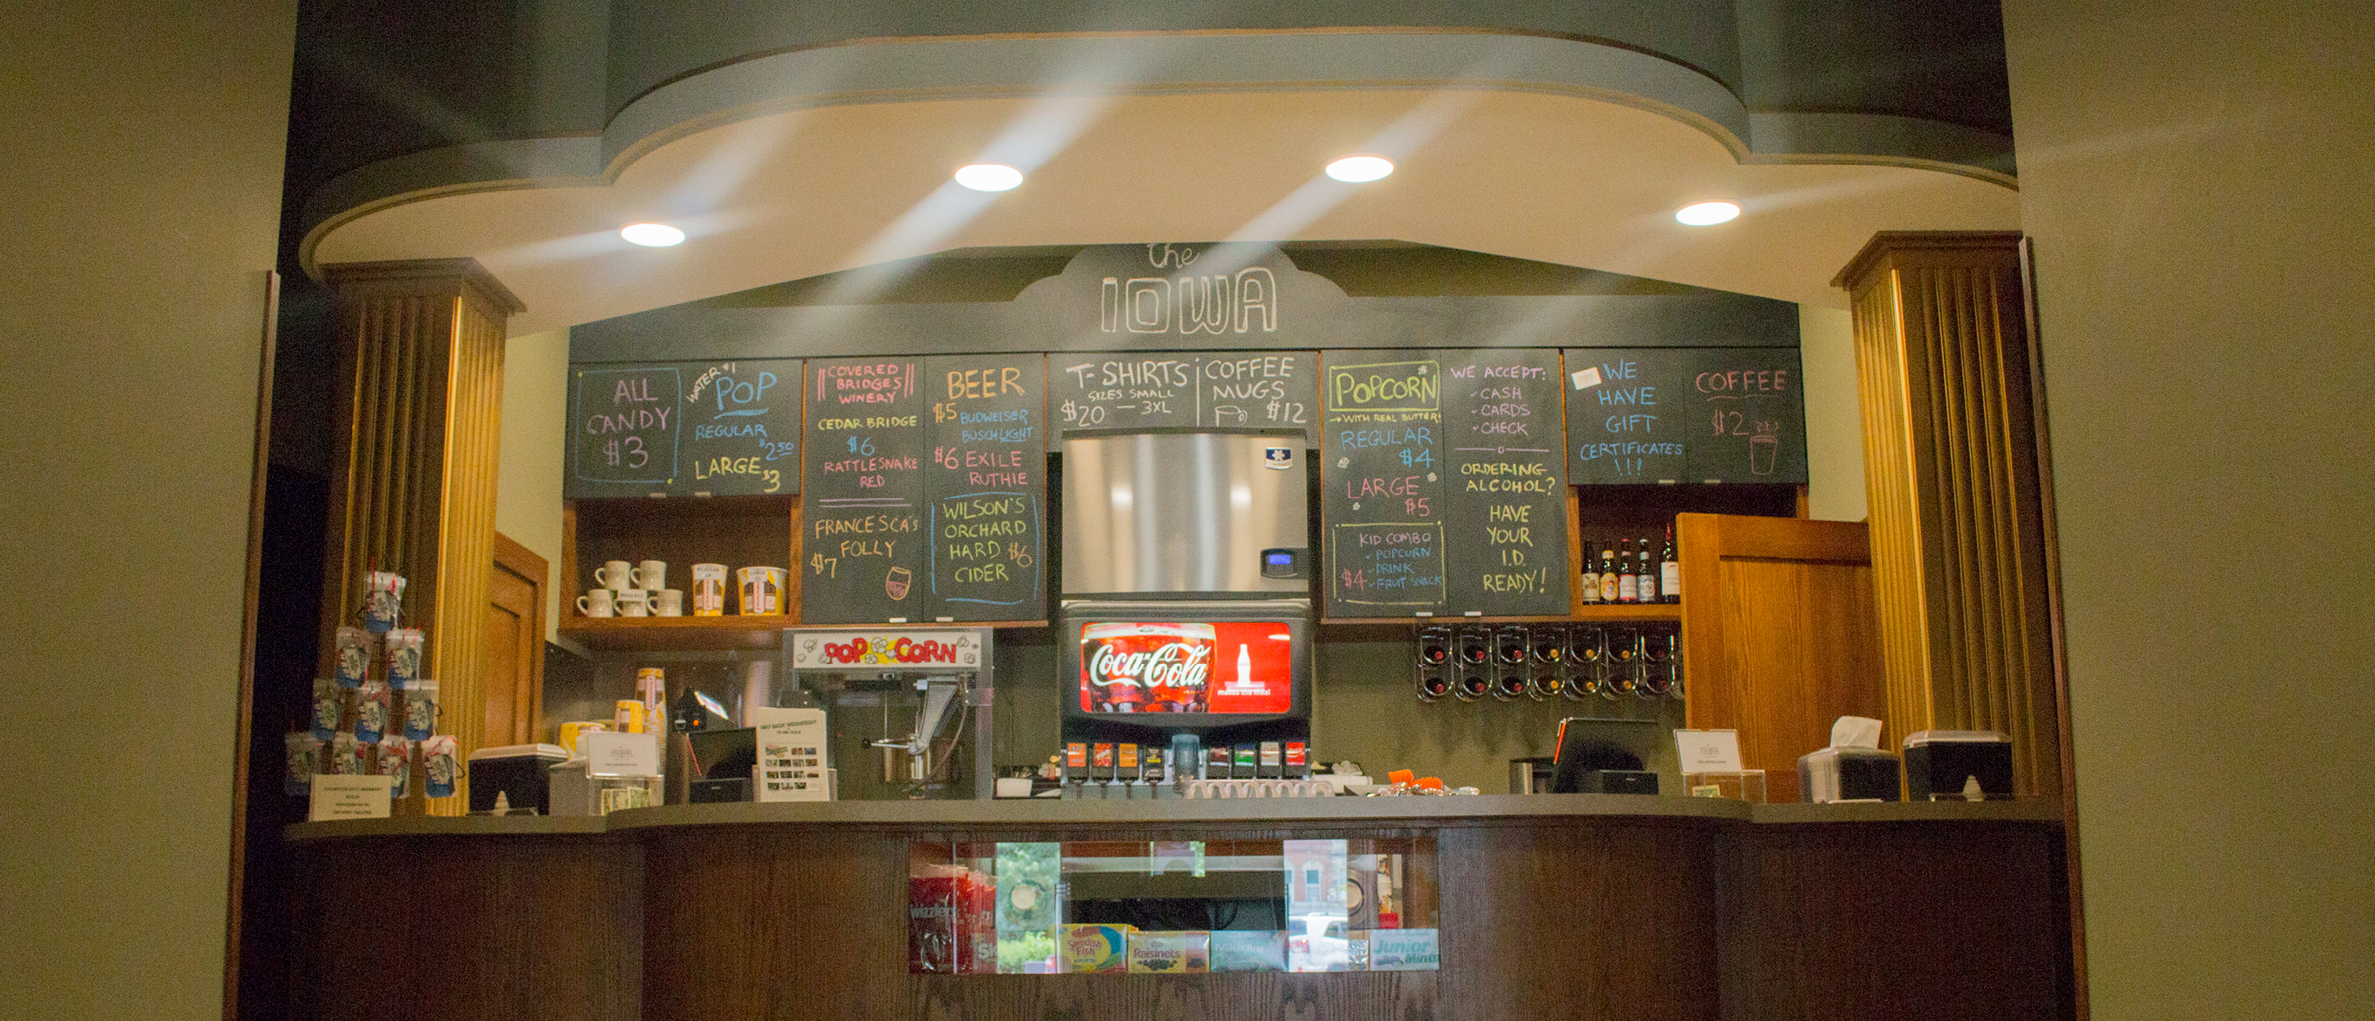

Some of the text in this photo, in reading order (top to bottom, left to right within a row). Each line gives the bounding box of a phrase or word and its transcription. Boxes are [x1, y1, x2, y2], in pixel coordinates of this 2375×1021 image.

[1146, 242, 1200, 268] the
[1101, 267, 1277, 335] IOWA
[827, 363, 899, 378] COVERED
[1066, 360, 1190, 388] T-SHIRTS
[1205, 356, 1295, 380] COFFEE
[1450, 366, 1547, 380] WE ACCEPT:
[1602, 358, 1637, 380] WE
[612, 378, 658, 405] ALL
[686, 366, 721, 403] WATER
[716, 372, 778, 411] POP
[836, 377, 902, 391] BRIDGES
[947, 367, 1025, 400] BEER
[1213, 380, 1285, 400] MUGS
[1335, 372, 1437, 406] POPCORN
[1695, 370, 1788, 394] COFFEE
[838, 391, 897, 404] WINERY
[1088, 388, 1174, 401] SIZES SMALL
[1480, 387, 1522, 400] CASH
[1598, 387, 1656, 406] HAVE
[932, 402, 1029, 425] $5 BUDWEISER
[1060, 399, 1105, 427] $20
[1140, 401, 1172, 414] 3XL
[1266, 400, 1307, 424] $12
[1481, 403, 1531, 417] CARDS
[586, 406, 671, 434] CANDY
[817, 415, 917, 430] CEDAR BRIDGE
[1342, 412, 1442, 424] WITH REAL BUTTER!
[1605, 414, 1658, 433] GIFT
[1712, 408, 1750, 436] $2
[695, 424, 768, 441] REGULAR
[1340, 427, 1433, 451] REGULAR
[1481, 422, 1529, 436] CHECK
[602, 436, 648, 469] $3
[846, 436, 875, 457] $6
[1580, 441, 1683, 460] CERTIFICATES
[694, 456, 761, 480] LARGE
[824, 456, 918, 475] RATTLESNAKE
[934, 446, 1022, 470] $6 EXILE
[1399, 448, 1435, 469] $4
[969, 471, 1028, 488] RUTHIE
[1460, 463, 1547, 477] ORDERING
[762, 469, 781, 493] $3
[860, 475, 885, 488] RED
[1347, 475, 1421, 499] LARGE
[1465, 476, 1556, 496] ALCOHOL?
[943, 497, 1026, 520] WILSON'S
[1405, 497, 1431, 517] $5
[1489, 505, 1532, 523] HAVE
[944, 520, 1027, 538] ORCHARD
[1486, 527, 1534, 547] YOUR
[840, 540, 896, 558] FOLLY
[1359, 532, 1432, 548] KID COMBO
[949, 541, 1033, 568] HARD $6
[1376, 547, 1431, 560] POPCORN
[1502, 549, 1526, 567] I.D.
[810, 552, 837, 578] $7
[954, 564, 1009, 583] CIDER
[1376, 563, 1415, 575] DRINK
[1341, 568, 1367, 591] $4
[1376, 575, 1443, 590] FRUIT SNACK
[824, 637, 957, 664] POP CORN
[1089, 642, 1212, 688] Coca-Cola
[1067, 938, 1102, 950] Swedish
[1075, 947, 1096, 956] Fish
[1133, 947, 1181, 959] Raisinets
[1372, 938, 1432, 955] Junior
[1404, 953, 1440, 964] Mints
